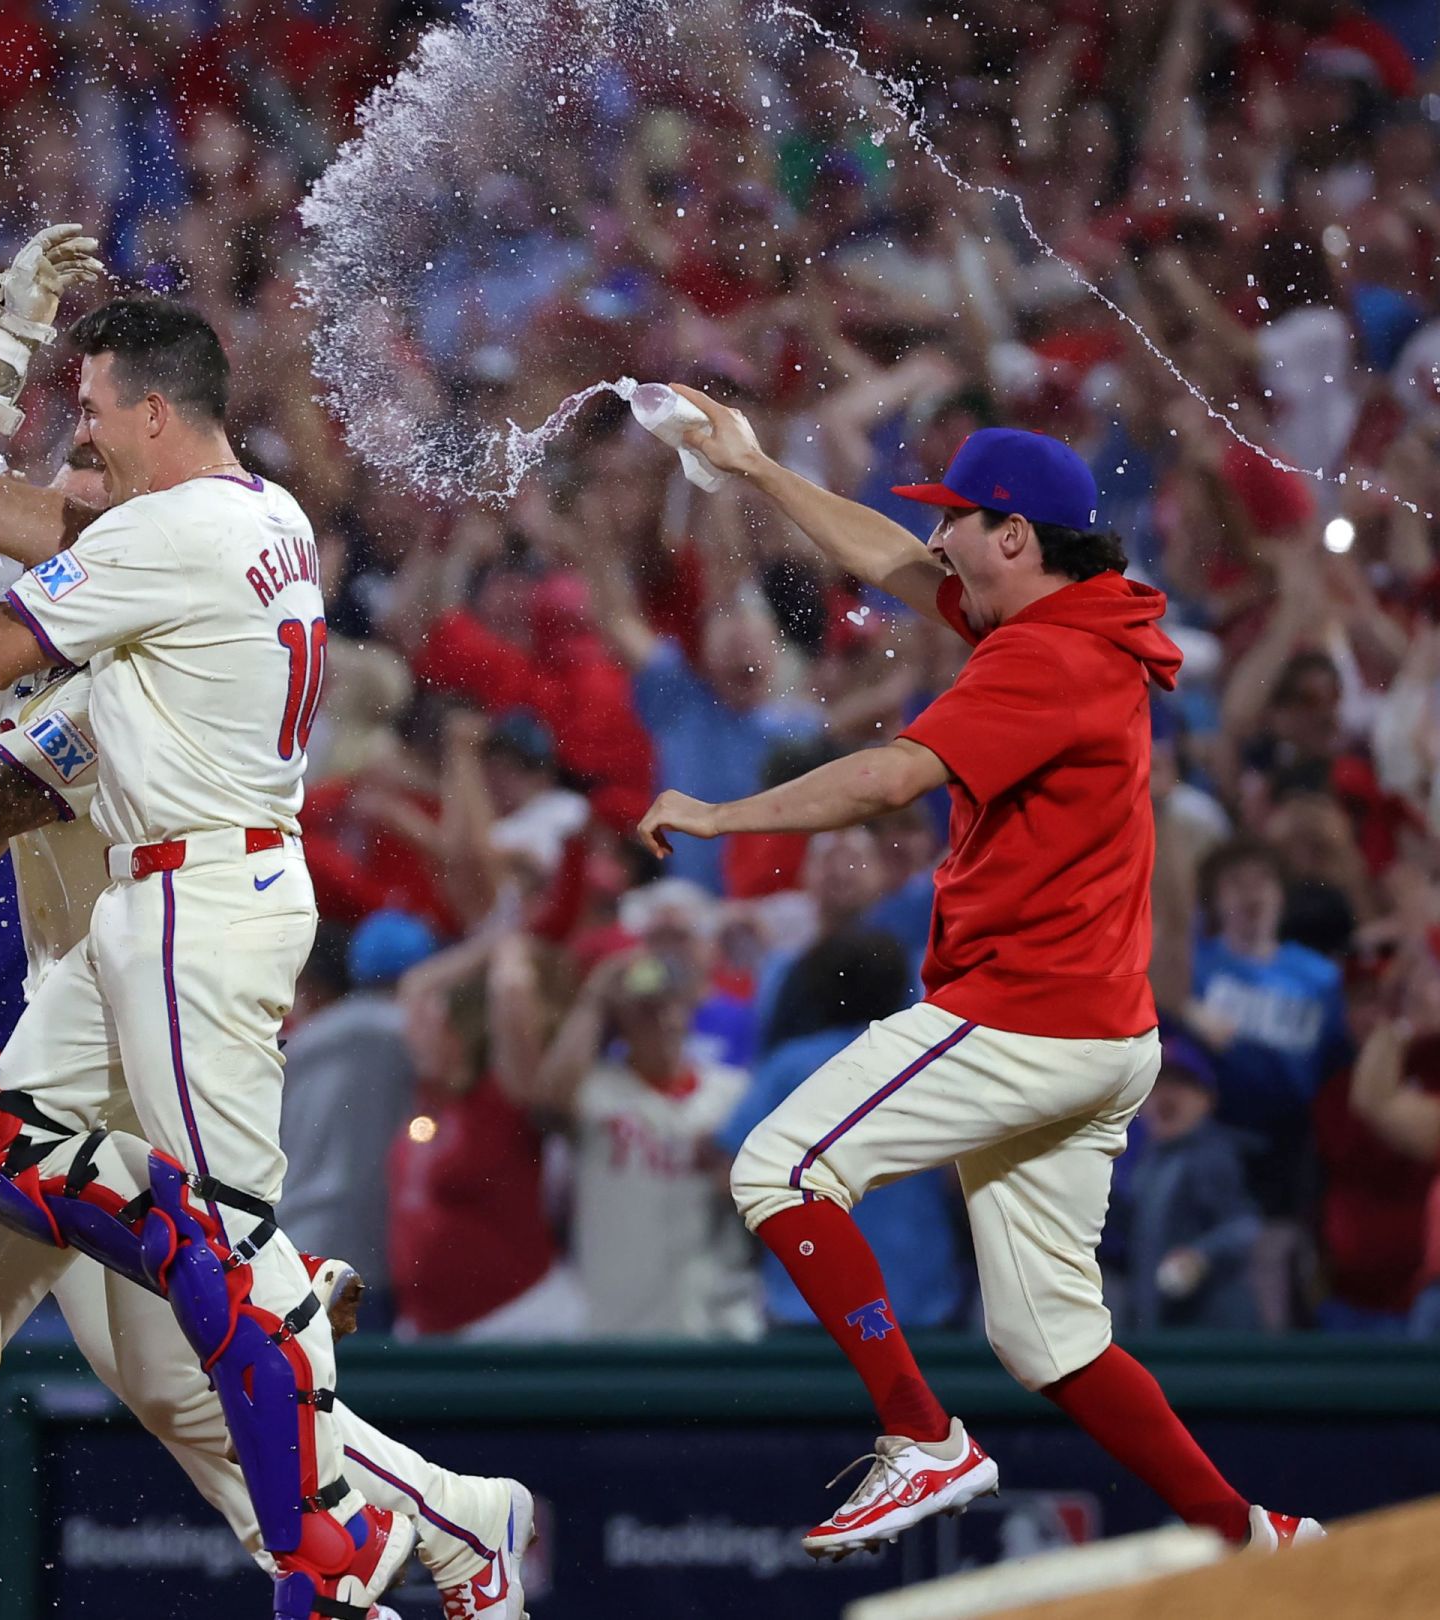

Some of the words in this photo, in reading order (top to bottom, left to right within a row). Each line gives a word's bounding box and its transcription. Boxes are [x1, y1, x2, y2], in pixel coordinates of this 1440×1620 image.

[35, 556, 74, 596] BX
[246, 537, 321, 608] REALMU
[277, 617, 327, 761] 10
[30, 718, 86, 778] IBX
